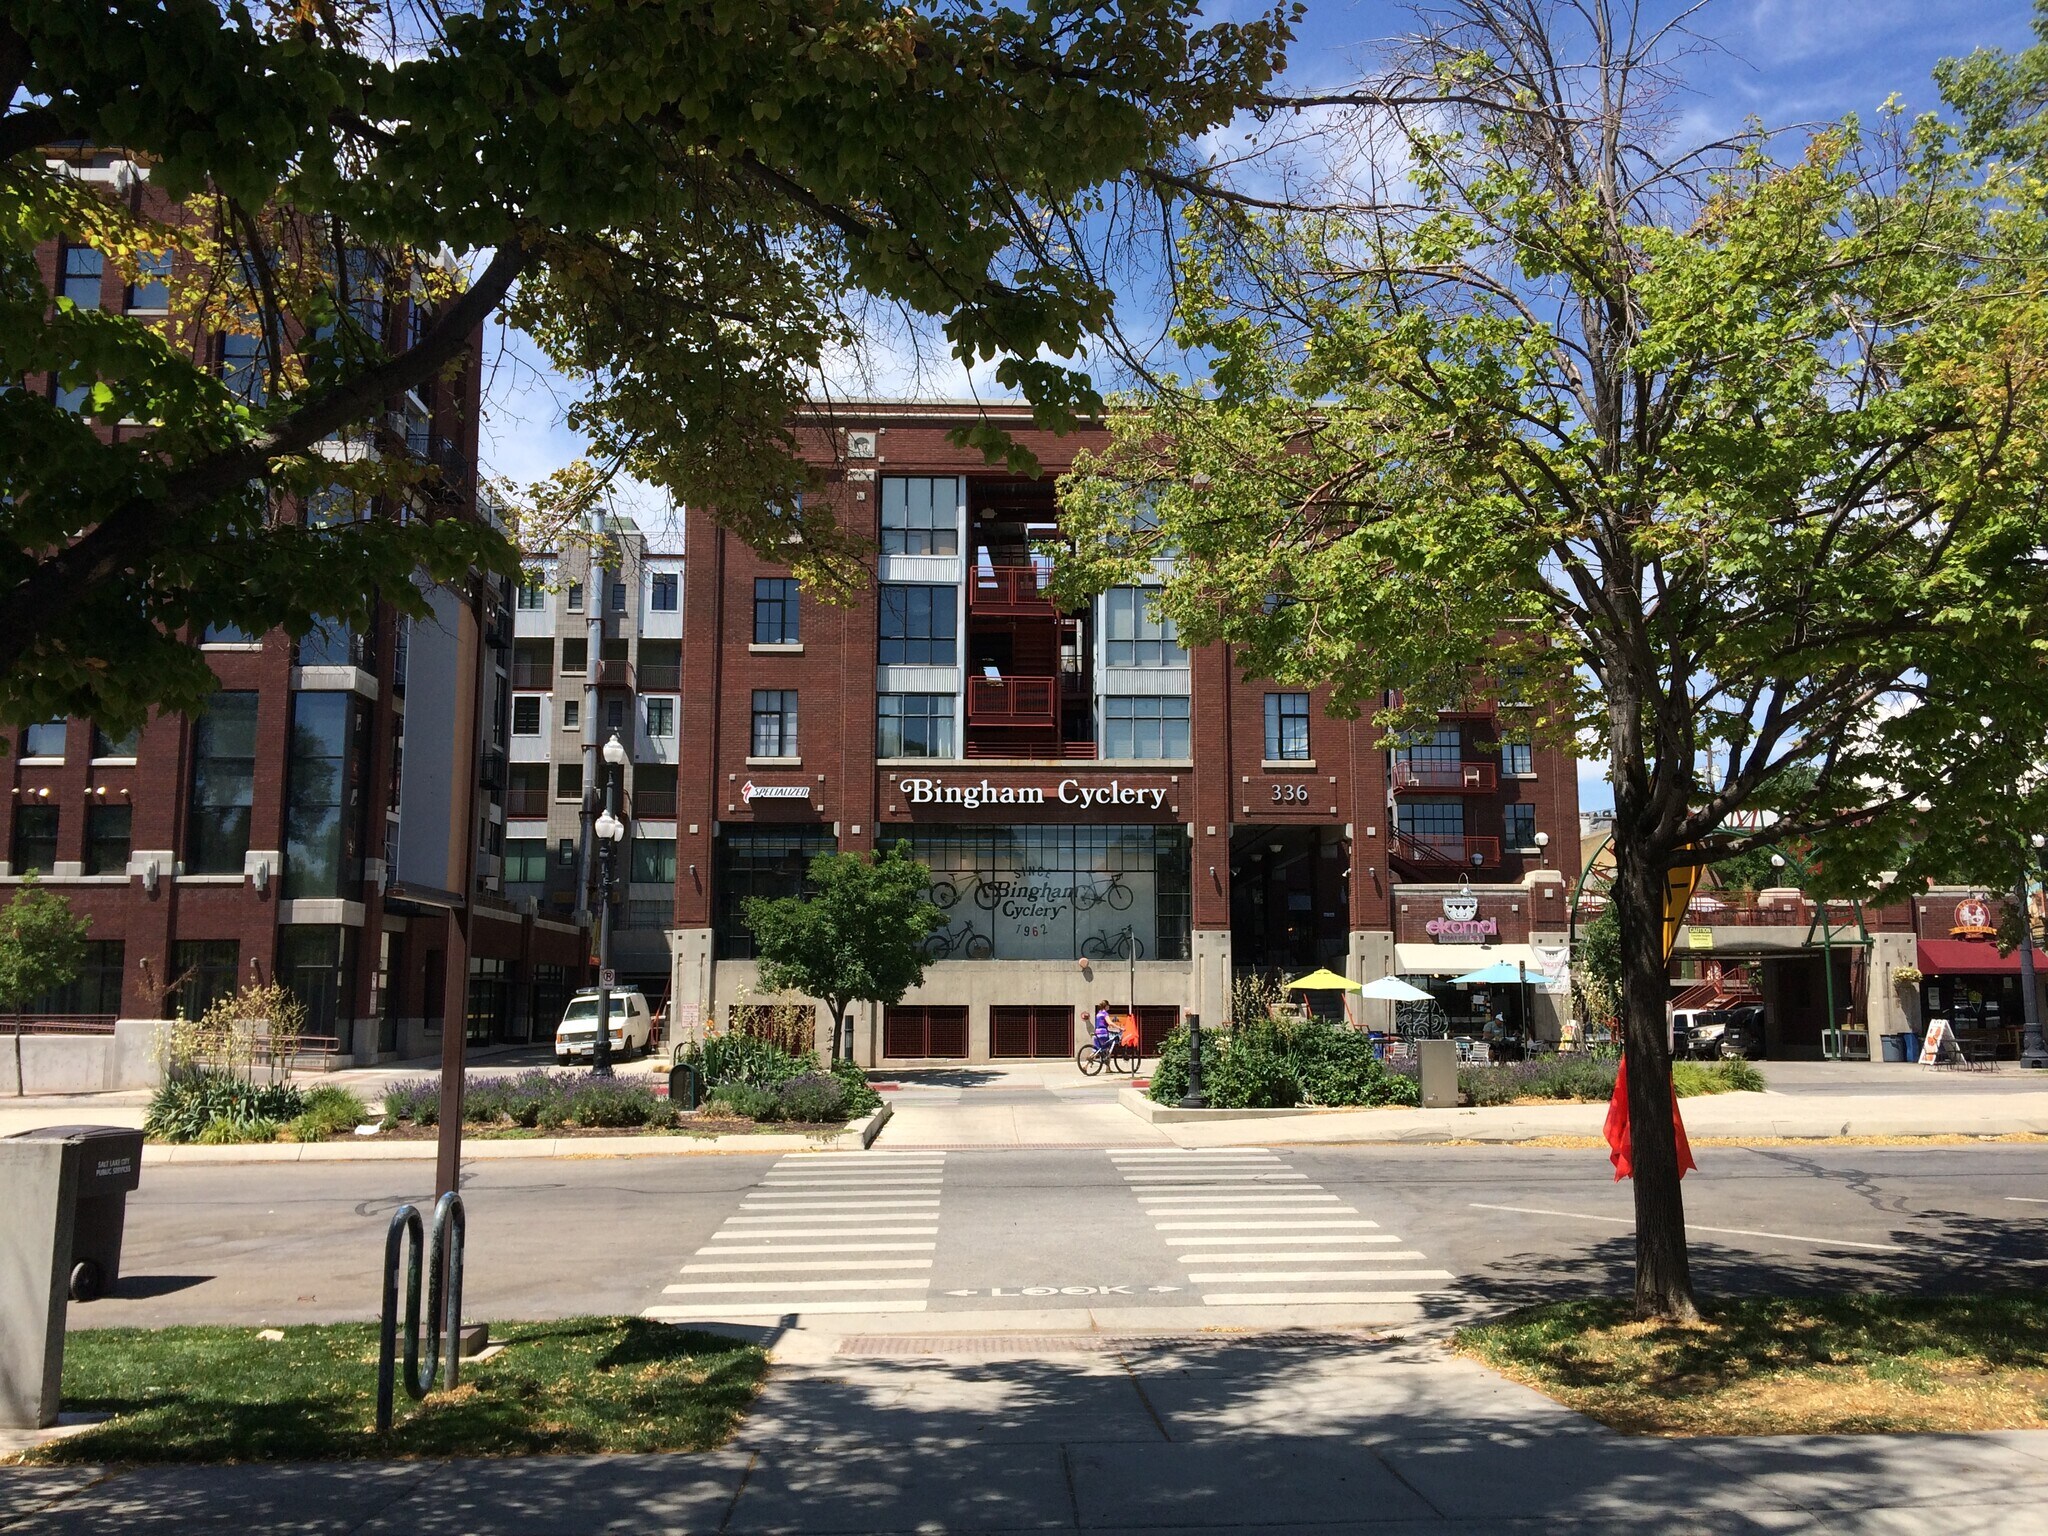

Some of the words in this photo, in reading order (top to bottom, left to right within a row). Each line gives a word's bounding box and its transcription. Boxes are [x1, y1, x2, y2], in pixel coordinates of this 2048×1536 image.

[754, 787, 808, 797] SPECIALIZED
[899, 778, 1045, 808] Bingham
[1058, 779, 1167, 809] Cyclery
[1271, 784, 1308, 801] 336
[1014, 866, 1051, 879] SINCE
[985, 881, 1079, 903] Bingham
[1002, 900, 1067, 920] Cyclery
[1015, 923, 1048, 937] 1962
[1425, 917, 1497, 935] ekamai
[992, 1285, 1134, 1297] LOOK
